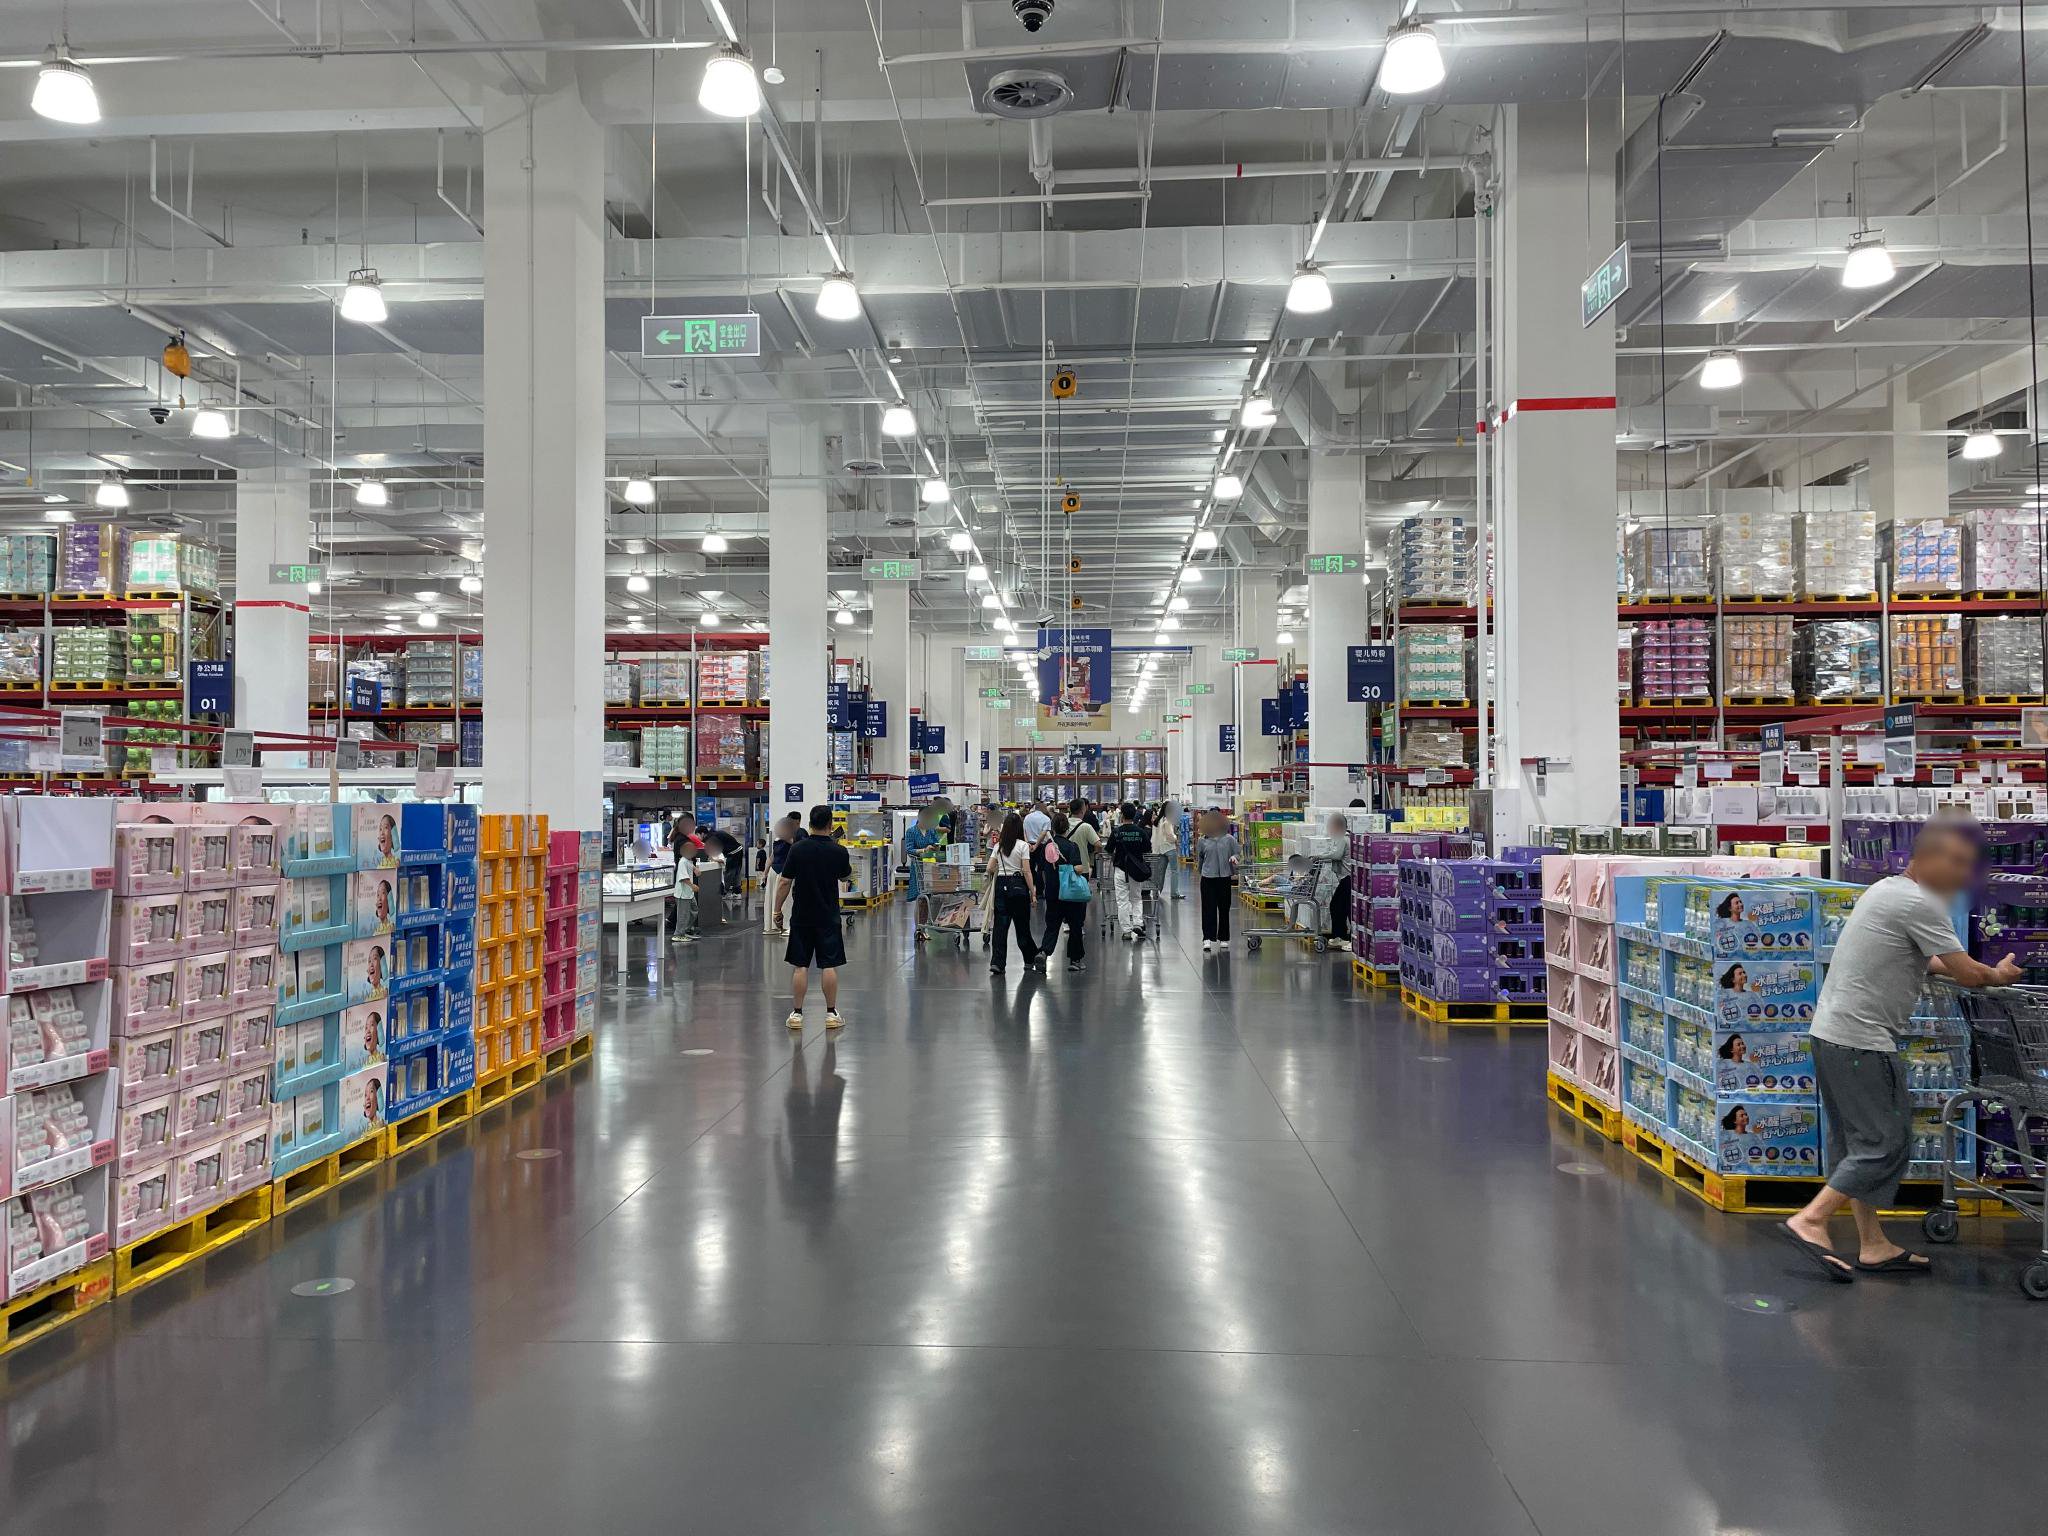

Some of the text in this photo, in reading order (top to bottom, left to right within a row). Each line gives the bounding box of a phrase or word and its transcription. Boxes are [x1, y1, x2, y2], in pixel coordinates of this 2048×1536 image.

[719, 323, 747, 338] 安全出口
[719, 339, 746, 348] EXIT
[1355, 649, 1386, 658] 婴儿奶粉
[197, 664, 224, 672] 办公用品
[1361, 685, 1381, 699] 30
[201, 698, 217, 710] 01
[1765, 738, 1780, 749] NEW
